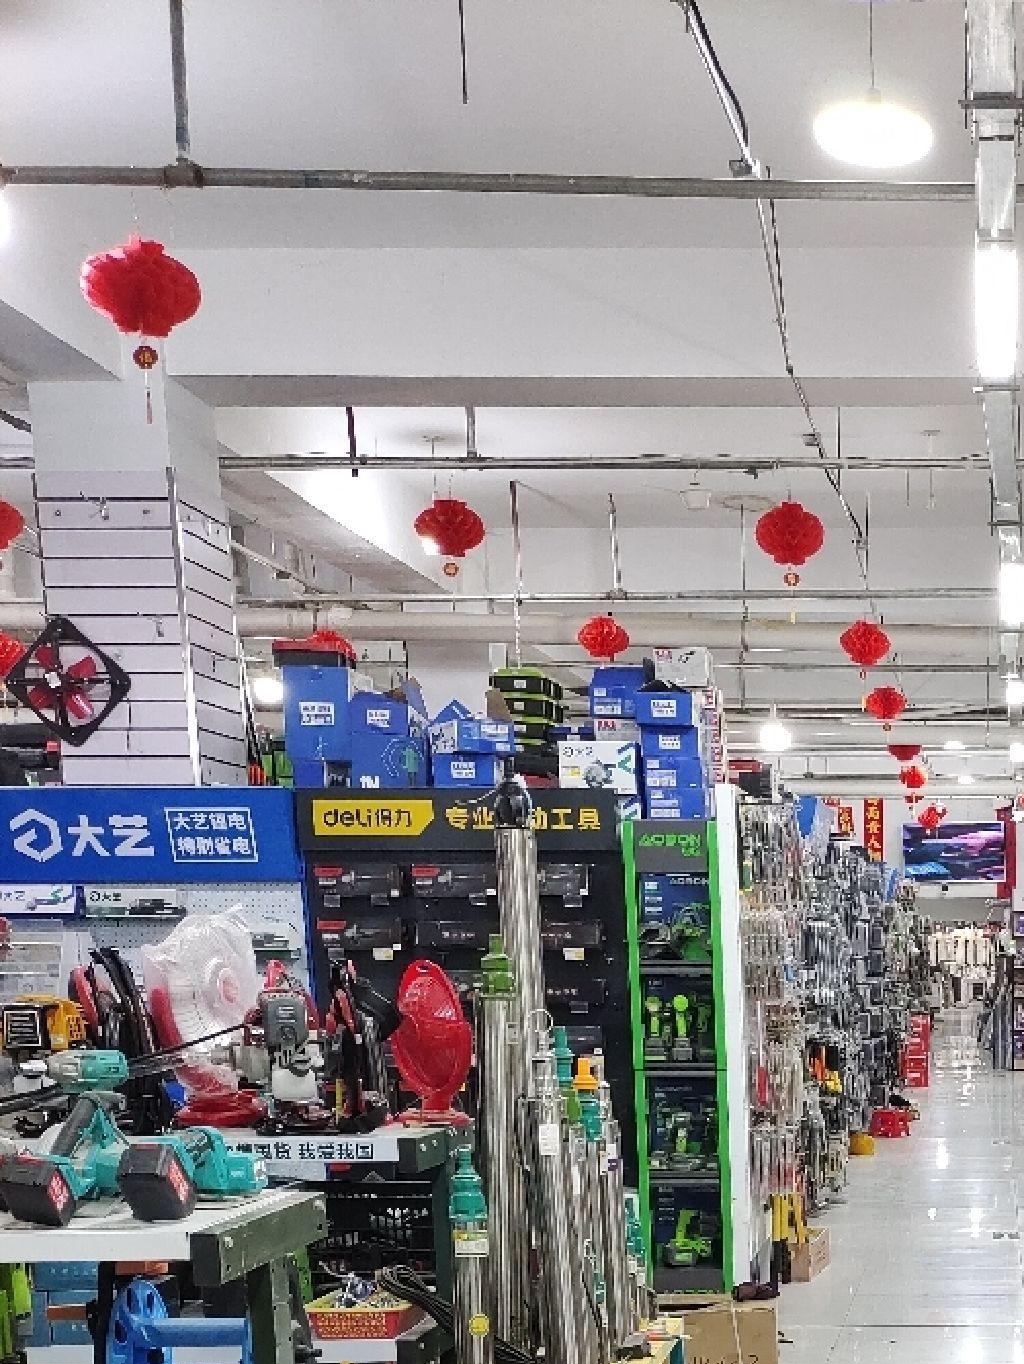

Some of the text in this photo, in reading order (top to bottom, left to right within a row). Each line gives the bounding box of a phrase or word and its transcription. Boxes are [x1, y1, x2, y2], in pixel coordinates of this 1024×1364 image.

[172, 812, 247, 830] 大艺锂电
[445, 806, 601, 831] 专业动工具
[67, 814, 155, 857] 大艺
[176, 836, 251, 856] 特别省电
